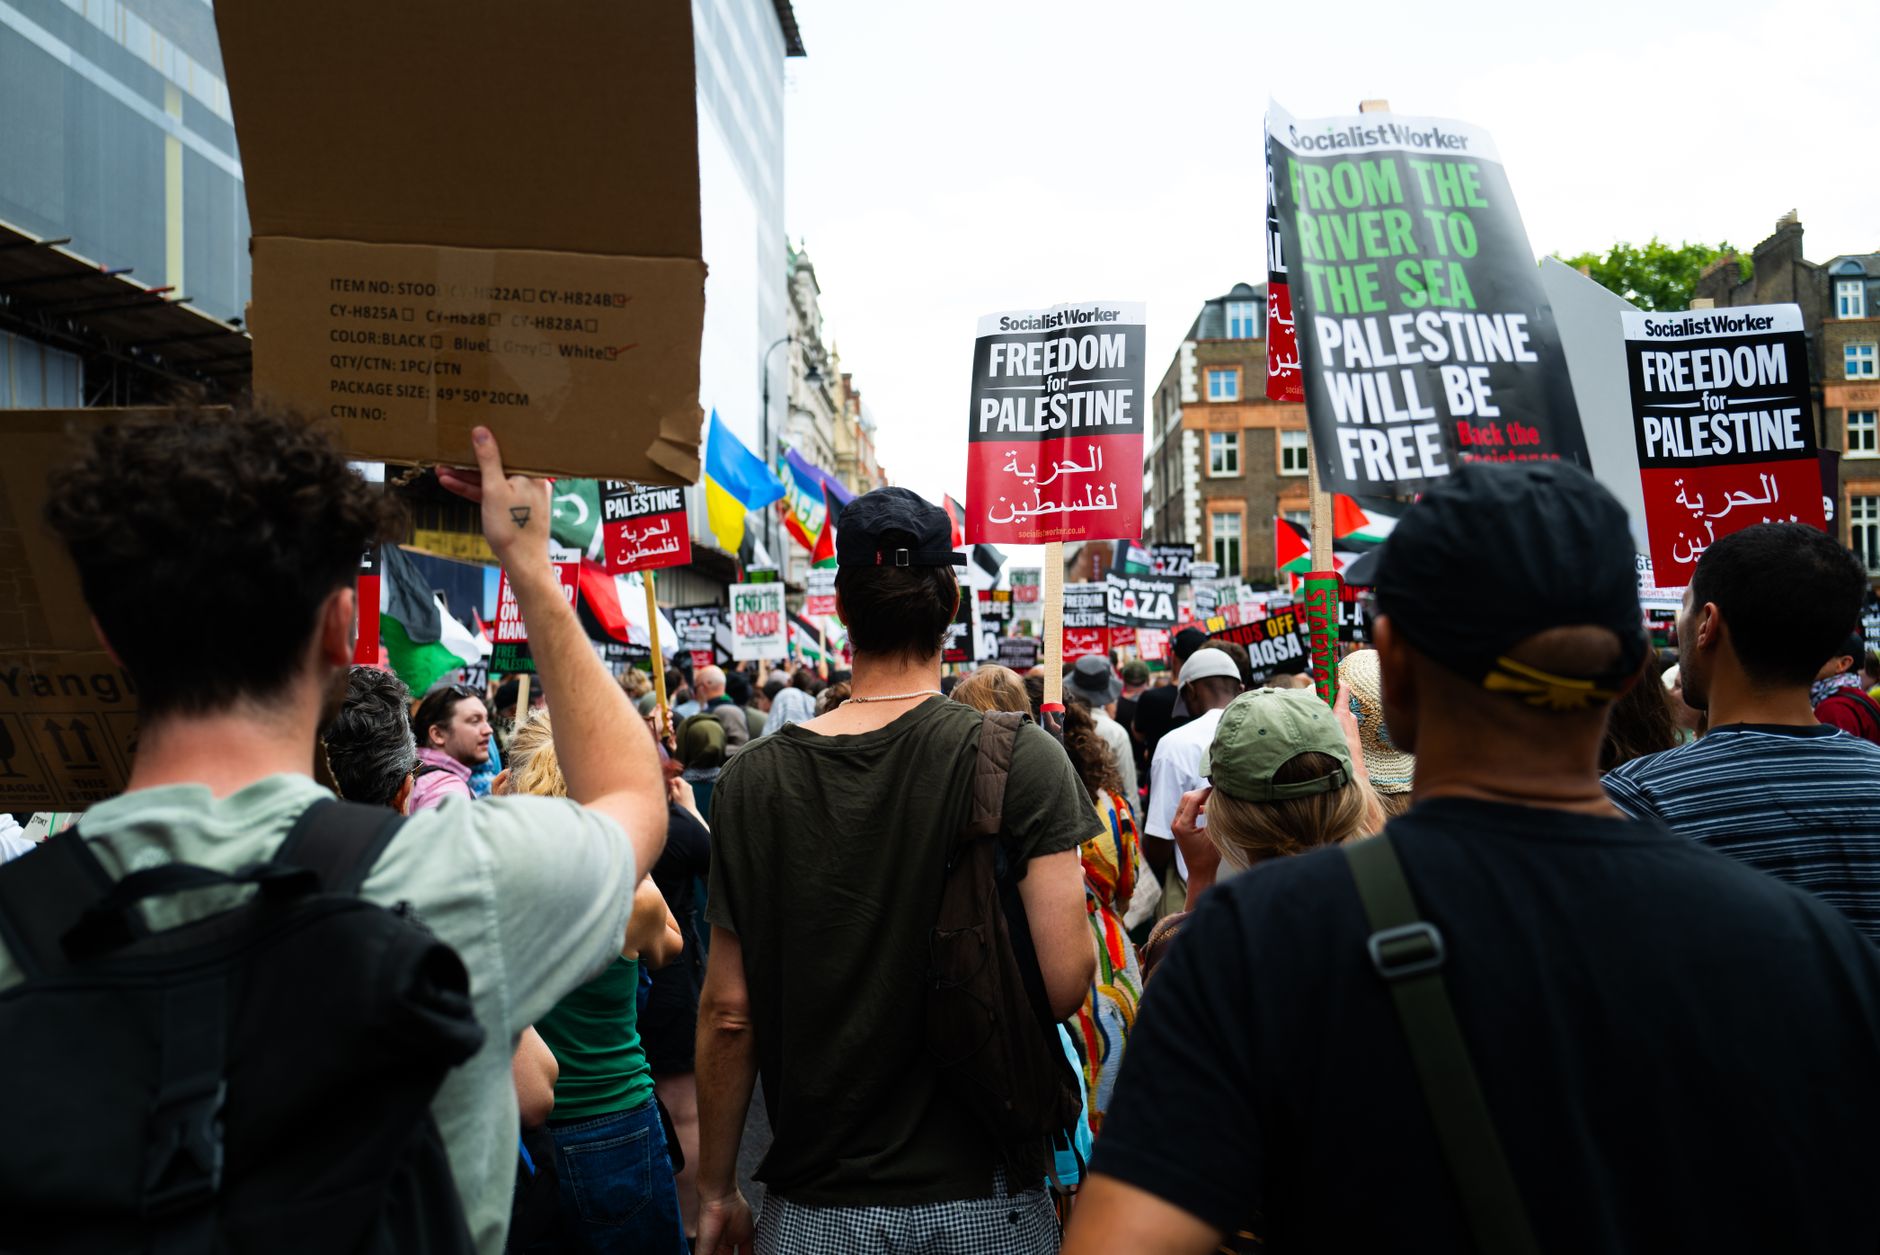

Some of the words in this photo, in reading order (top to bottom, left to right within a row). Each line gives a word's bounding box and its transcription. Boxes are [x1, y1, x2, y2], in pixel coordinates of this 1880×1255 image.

[1288, 157, 1404, 210] FROM
[1409, 159, 1489, 209] THE
[1296, 210, 1418, 261] RIVER
[1423, 209, 1479, 259] TO
[330, 279, 365, 293] ITEM
[369, 281, 394, 295] NO:
[539, 290, 612, 307] CY-H824B
[1302, 262, 1387, 314] THE
[1395, 259, 1477, 310] SEA
[330, 304, 398, 321] CY-H825A
[454, 336, 487, 352] Blue
[559, 344, 605, 361] White
[989, 333, 1126, 377] FREEDOM
[1314, 310, 1538, 369] PALESTINE
[330, 355, 396, 372] QTY/CTN:
[400, 358, 462, 376] 1PC/CTN
[1641, 343, 1788, 392] FREEDOM
[330, 380, 395, 397] PACKAGE
[396, 383, 430, 400] SIZE:
[1047, 375, 1068, 393] for
[1324, 369, 1436, 424] WILL
[1440, 365, 1500, 418] BE
[1701, 390, 1727, 411] for
[330, 405, 359, 419] CTN
[361, 407, 387, 422] NO:
[979, 389, 1133, 433] PALESTINE
[1456, 421, 1504, 447] Back
[1507, 421, 1540, 446] the
[1643, 408, 1805, 458] PALESTINE
[1002, 444, 1103, 486] الحرية
[1337, 422, 1450, 482] FREE
[605, 489, 682, 519] PALESTINE
[988, 482, 1117, 524] لفلسطين
[1675, 472, 1779, 518] الحرية
[1107, 586, 1176, 621] GAZA
[1129, 578, 1174, 595] Starving
[1266, 614, 1294, 638] OFF
[496, 646, 518, 658] FREE
